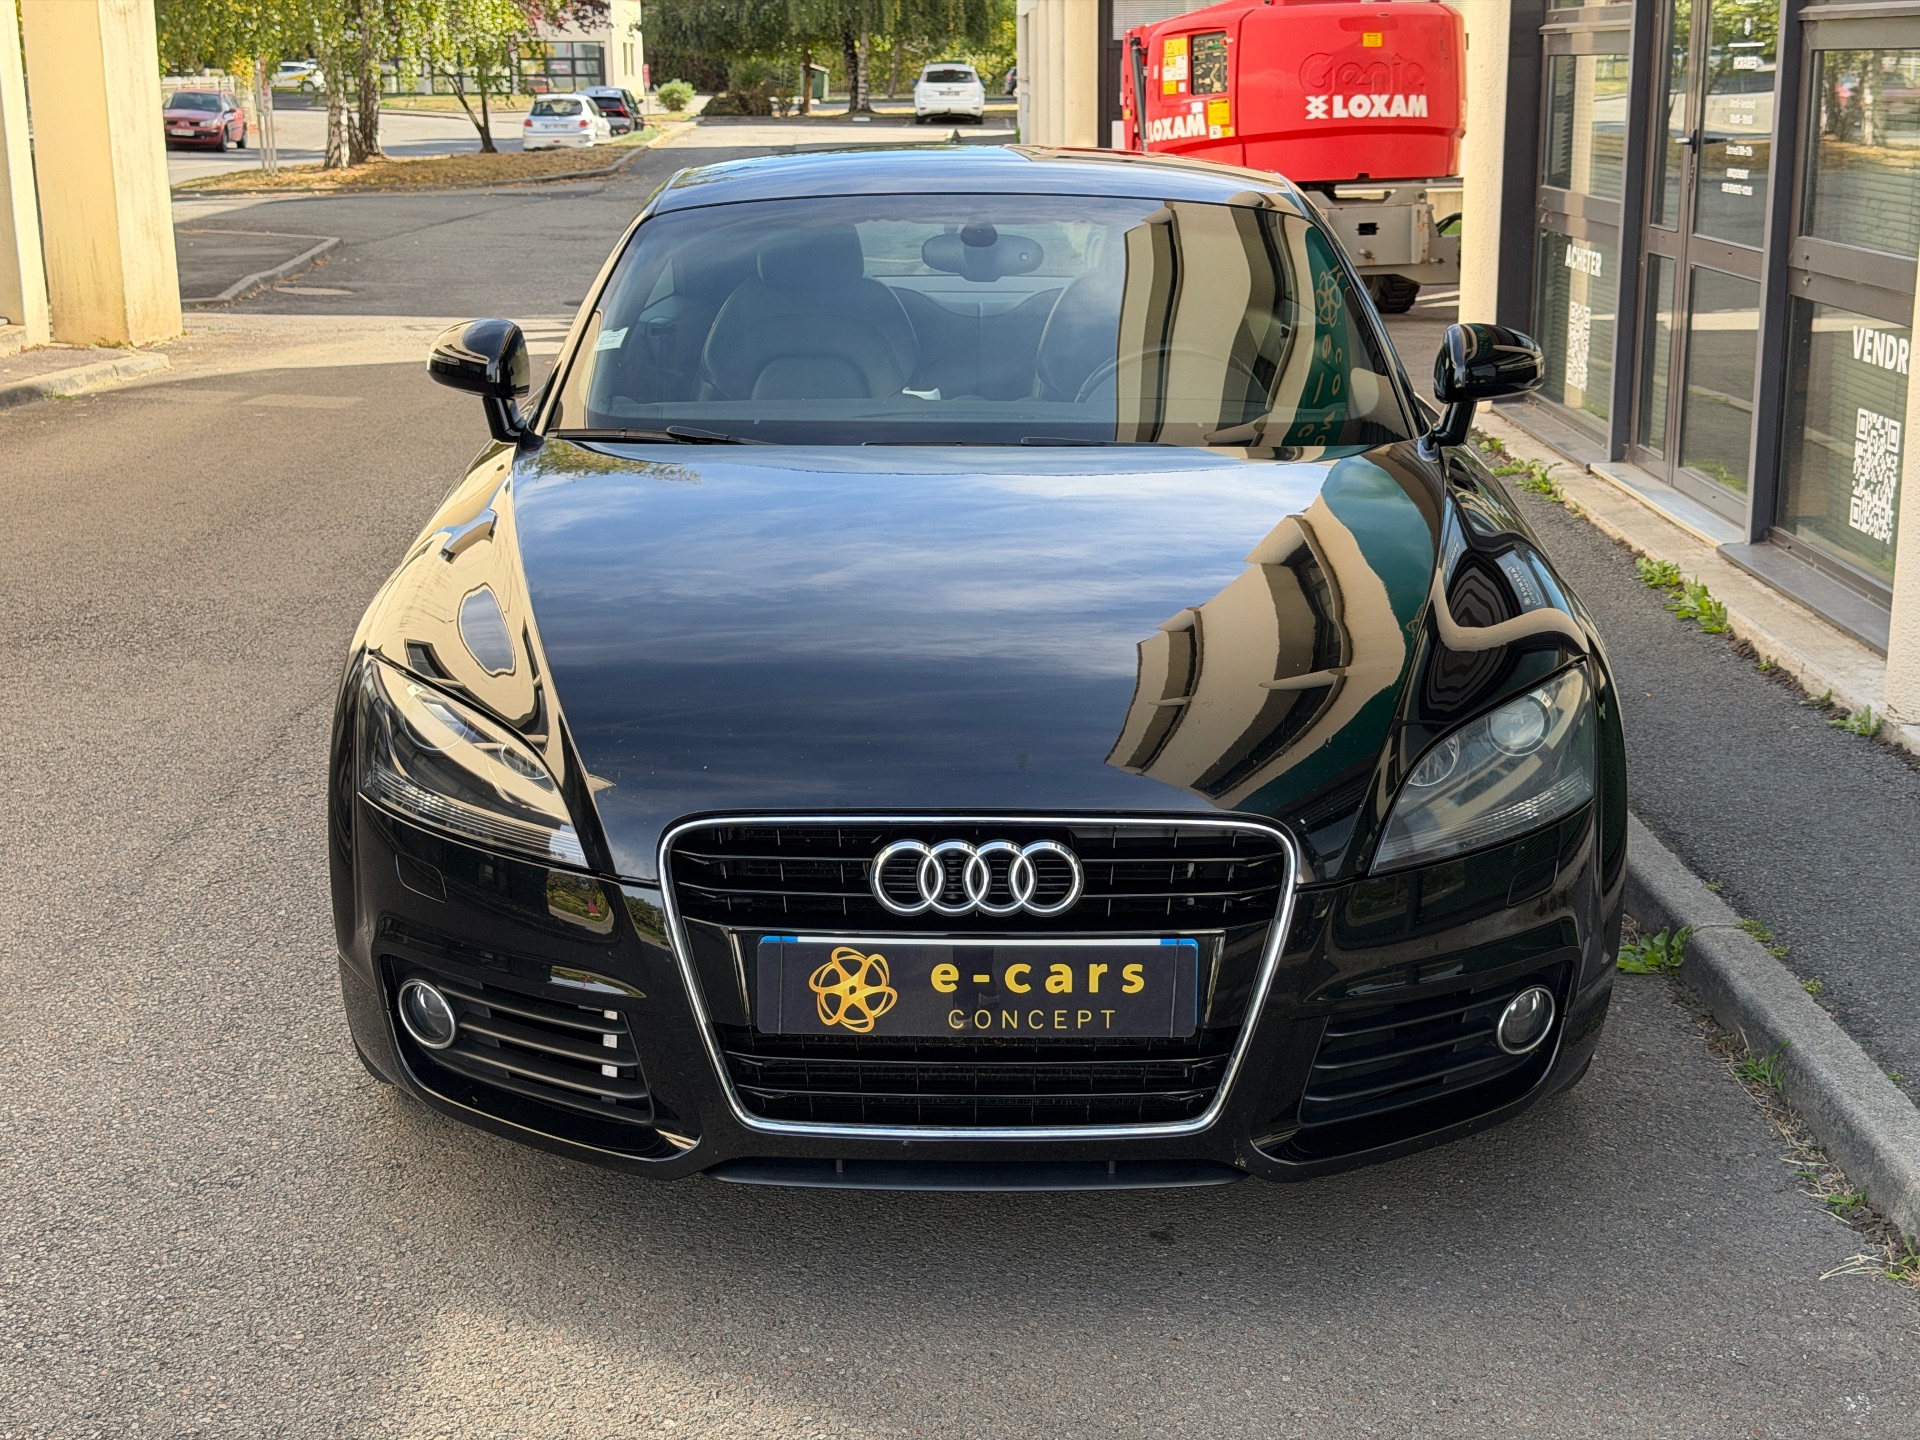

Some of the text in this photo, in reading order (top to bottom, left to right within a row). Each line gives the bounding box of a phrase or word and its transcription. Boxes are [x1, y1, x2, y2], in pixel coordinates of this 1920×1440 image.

[1332, 94, 1428, 118] LOXAM
[1147, 113, 1207, 143] LOXAM
[1564, 243, 1602, 278] ACHETER
[1852, 325, 1909, 375] VENDR
[931, 963, 1145, 994] e-cars
[948, 1010, 1116, 1029] CONCEPT
